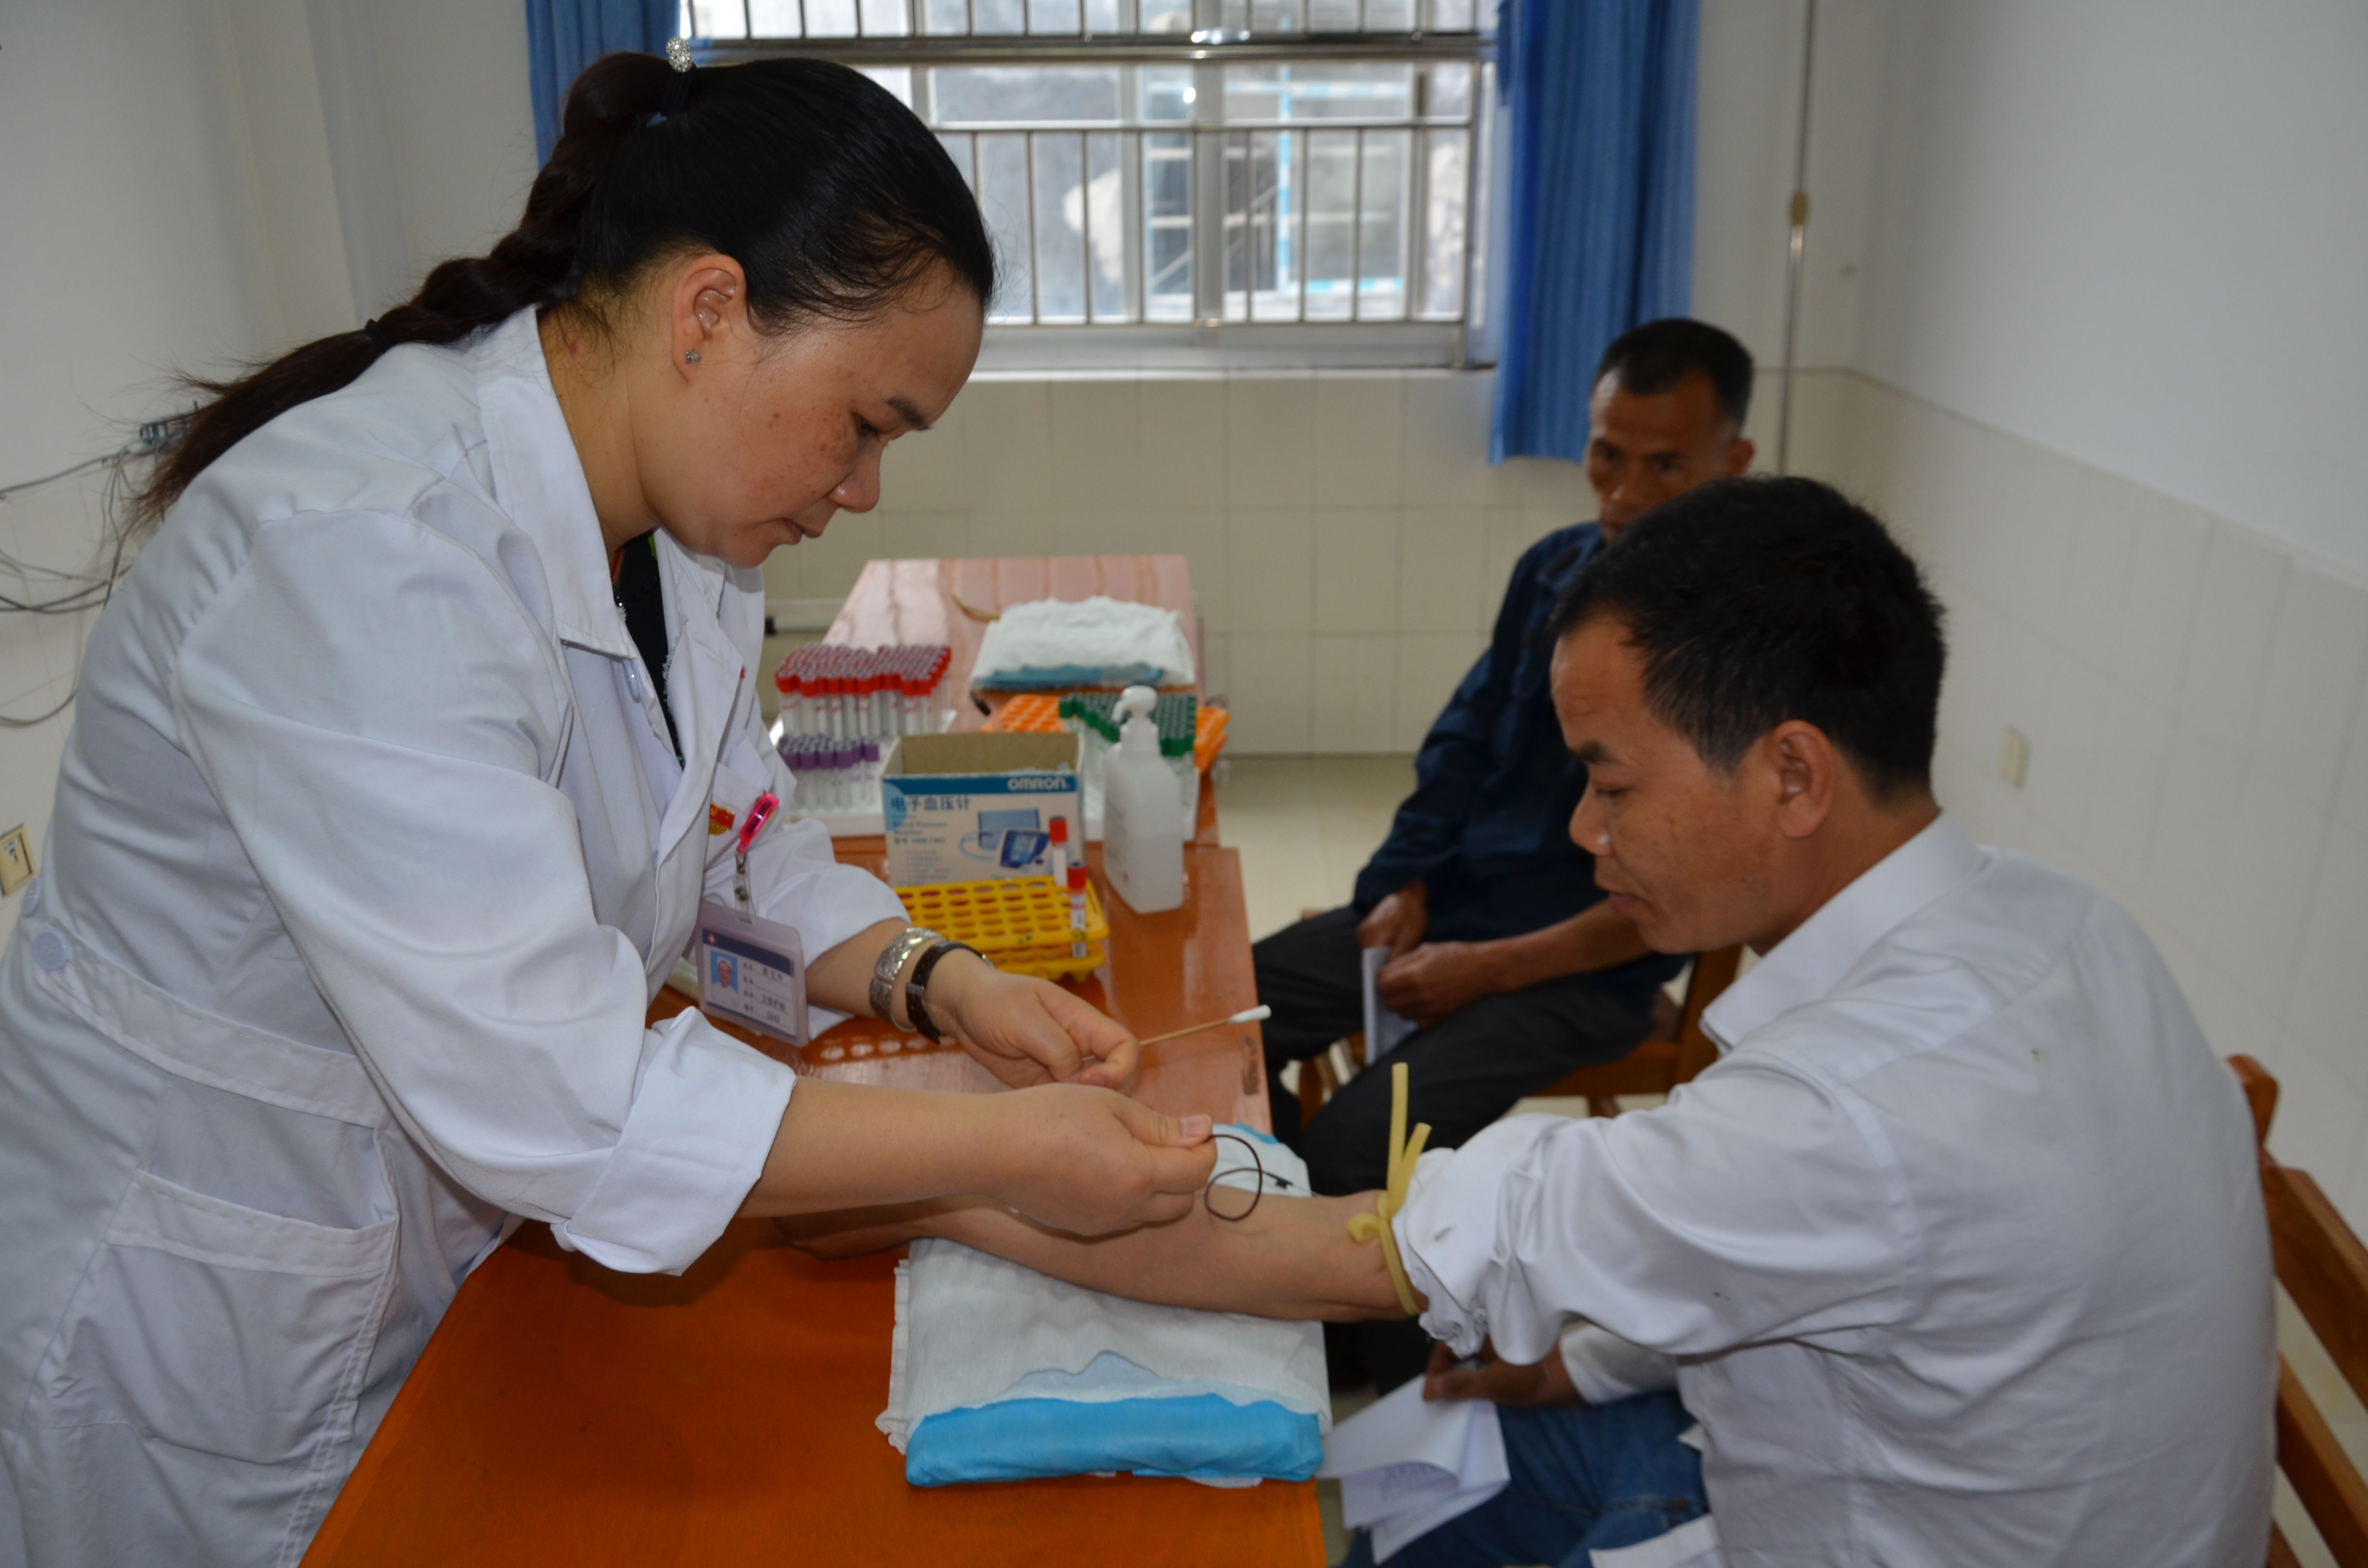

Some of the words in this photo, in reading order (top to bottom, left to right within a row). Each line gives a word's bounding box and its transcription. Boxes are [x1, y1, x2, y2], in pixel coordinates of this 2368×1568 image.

[890, 795, 970, 811] 电子血压计
